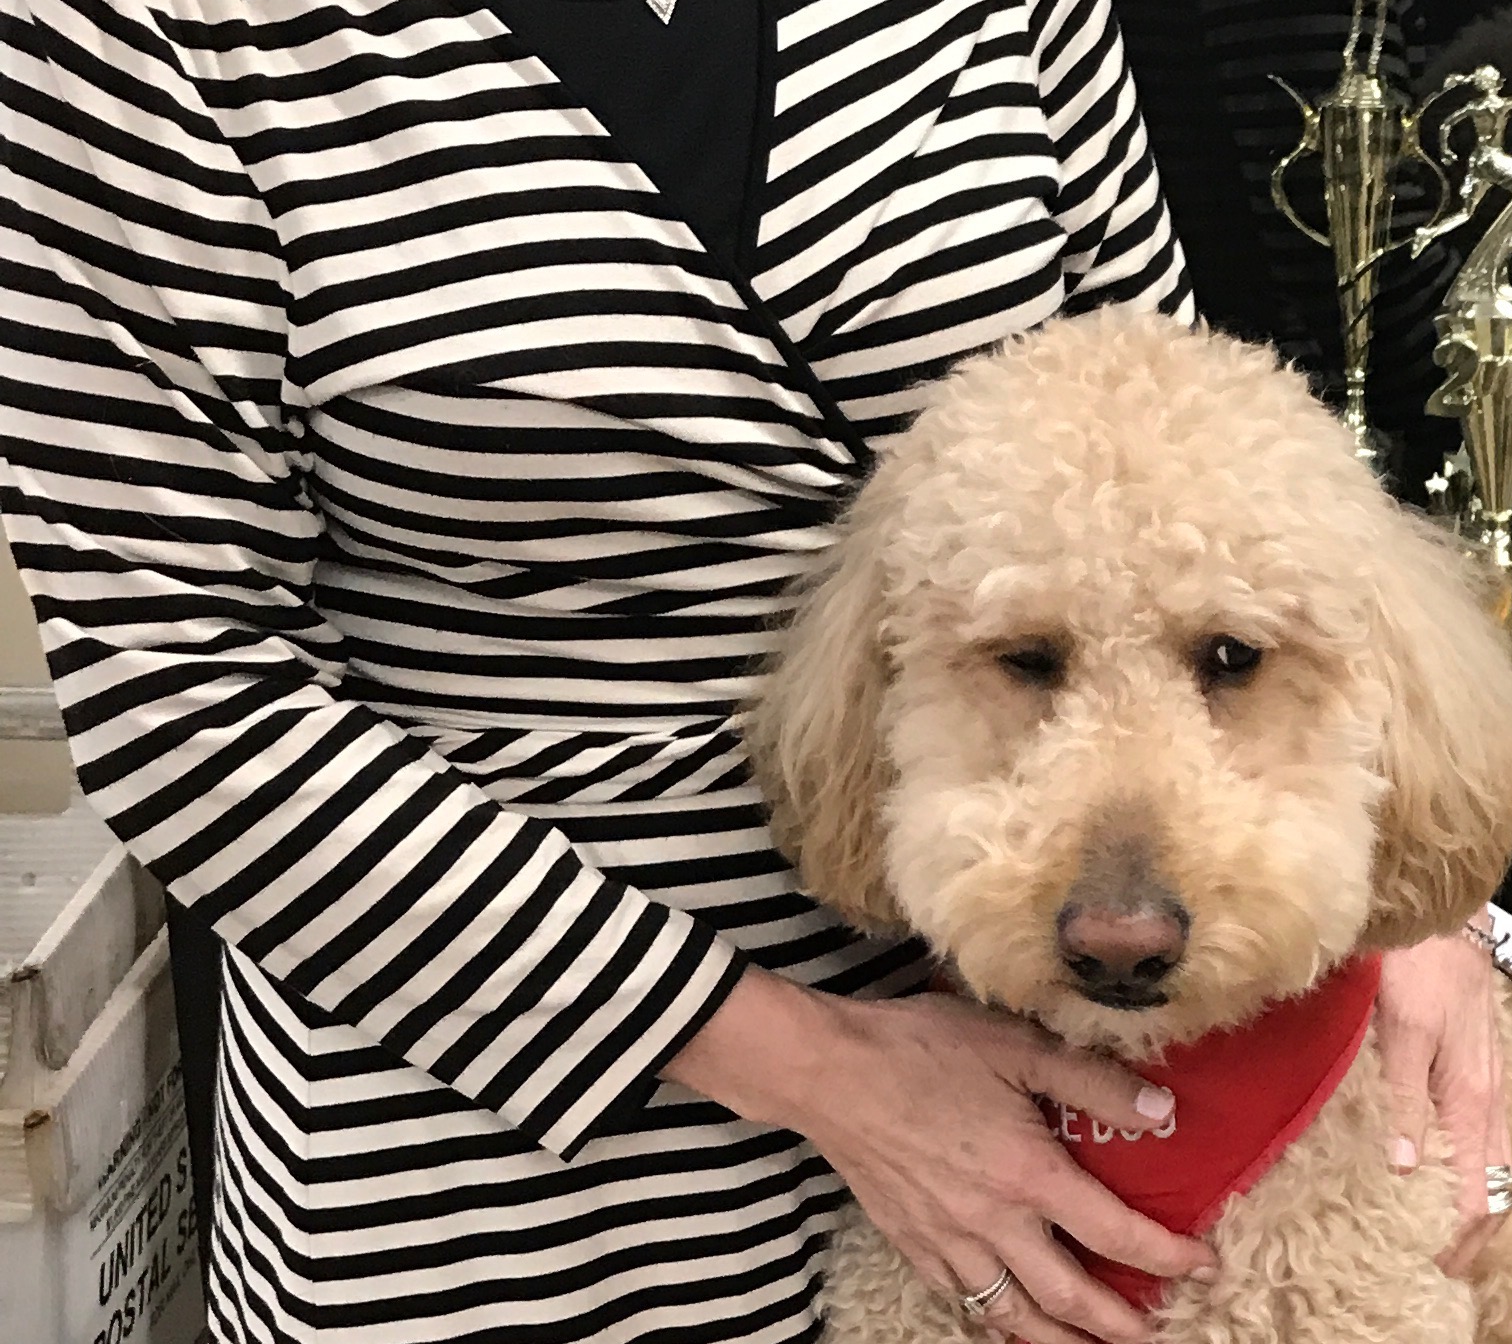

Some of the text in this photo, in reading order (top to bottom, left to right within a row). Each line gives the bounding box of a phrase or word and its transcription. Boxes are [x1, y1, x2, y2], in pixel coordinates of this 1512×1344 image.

[98, 1171, 173, 1307] UNITED
[175, 1145, 191, 1195] S
[176, 1196, 198, 1257] SE
